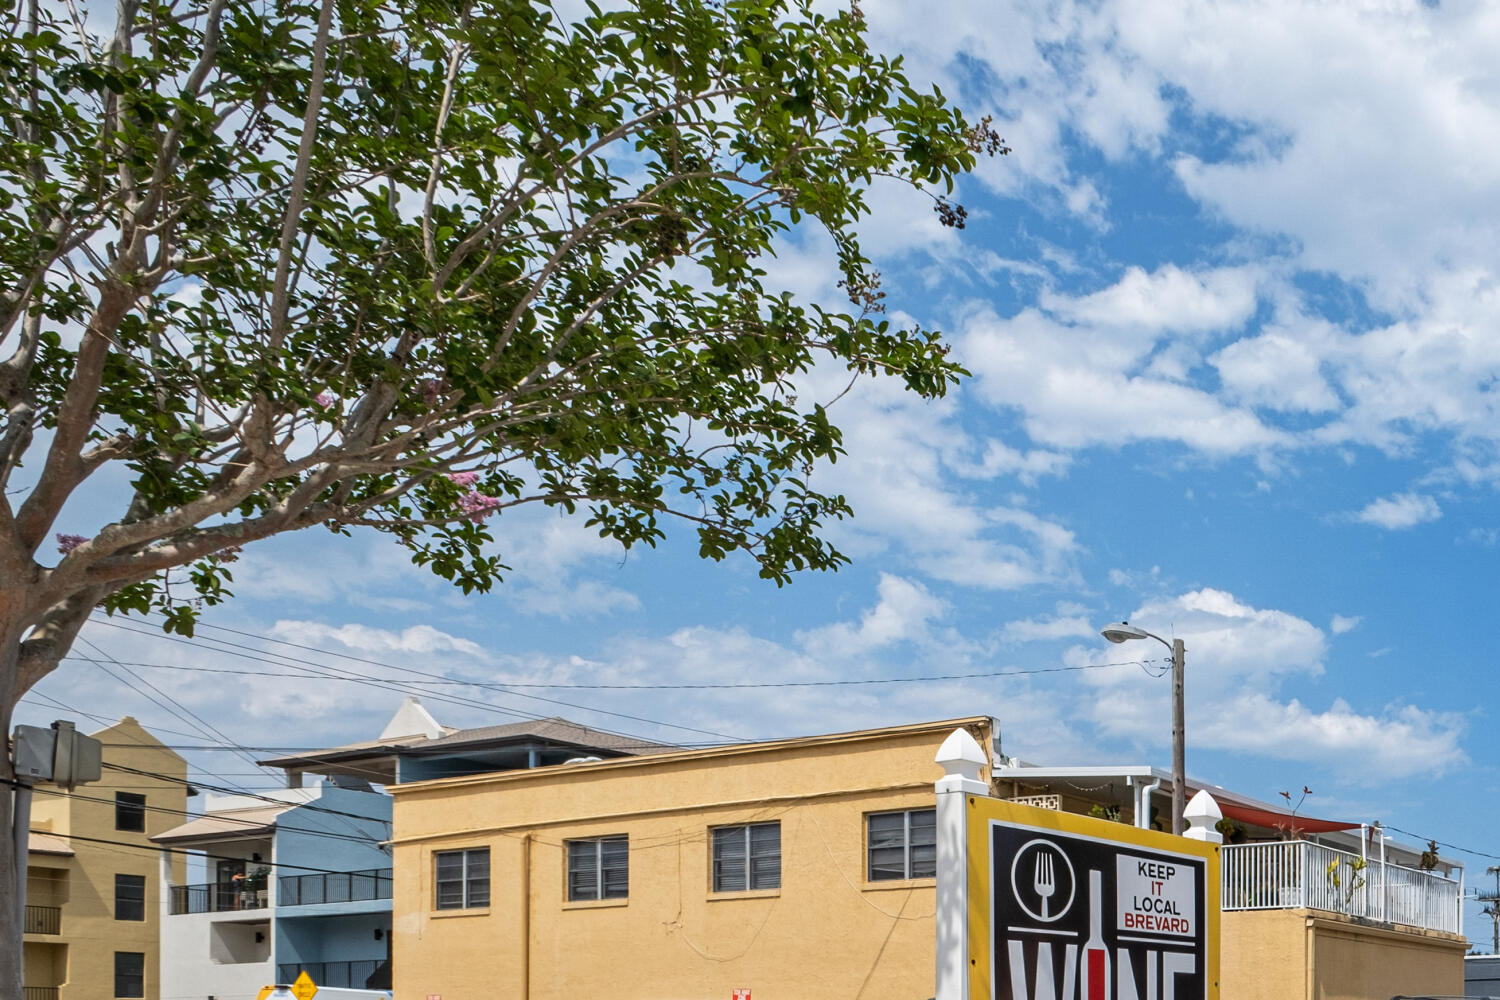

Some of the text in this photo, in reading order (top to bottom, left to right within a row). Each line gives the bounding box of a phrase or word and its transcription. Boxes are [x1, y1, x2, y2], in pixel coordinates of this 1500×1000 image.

[1137, 861, 1176, 881] KEEP
[1151, 880, 1164, 896] IT
[1133, 895, 1181, 916] LOCAL
[1124, 912, 1190, 934] BREVARD
